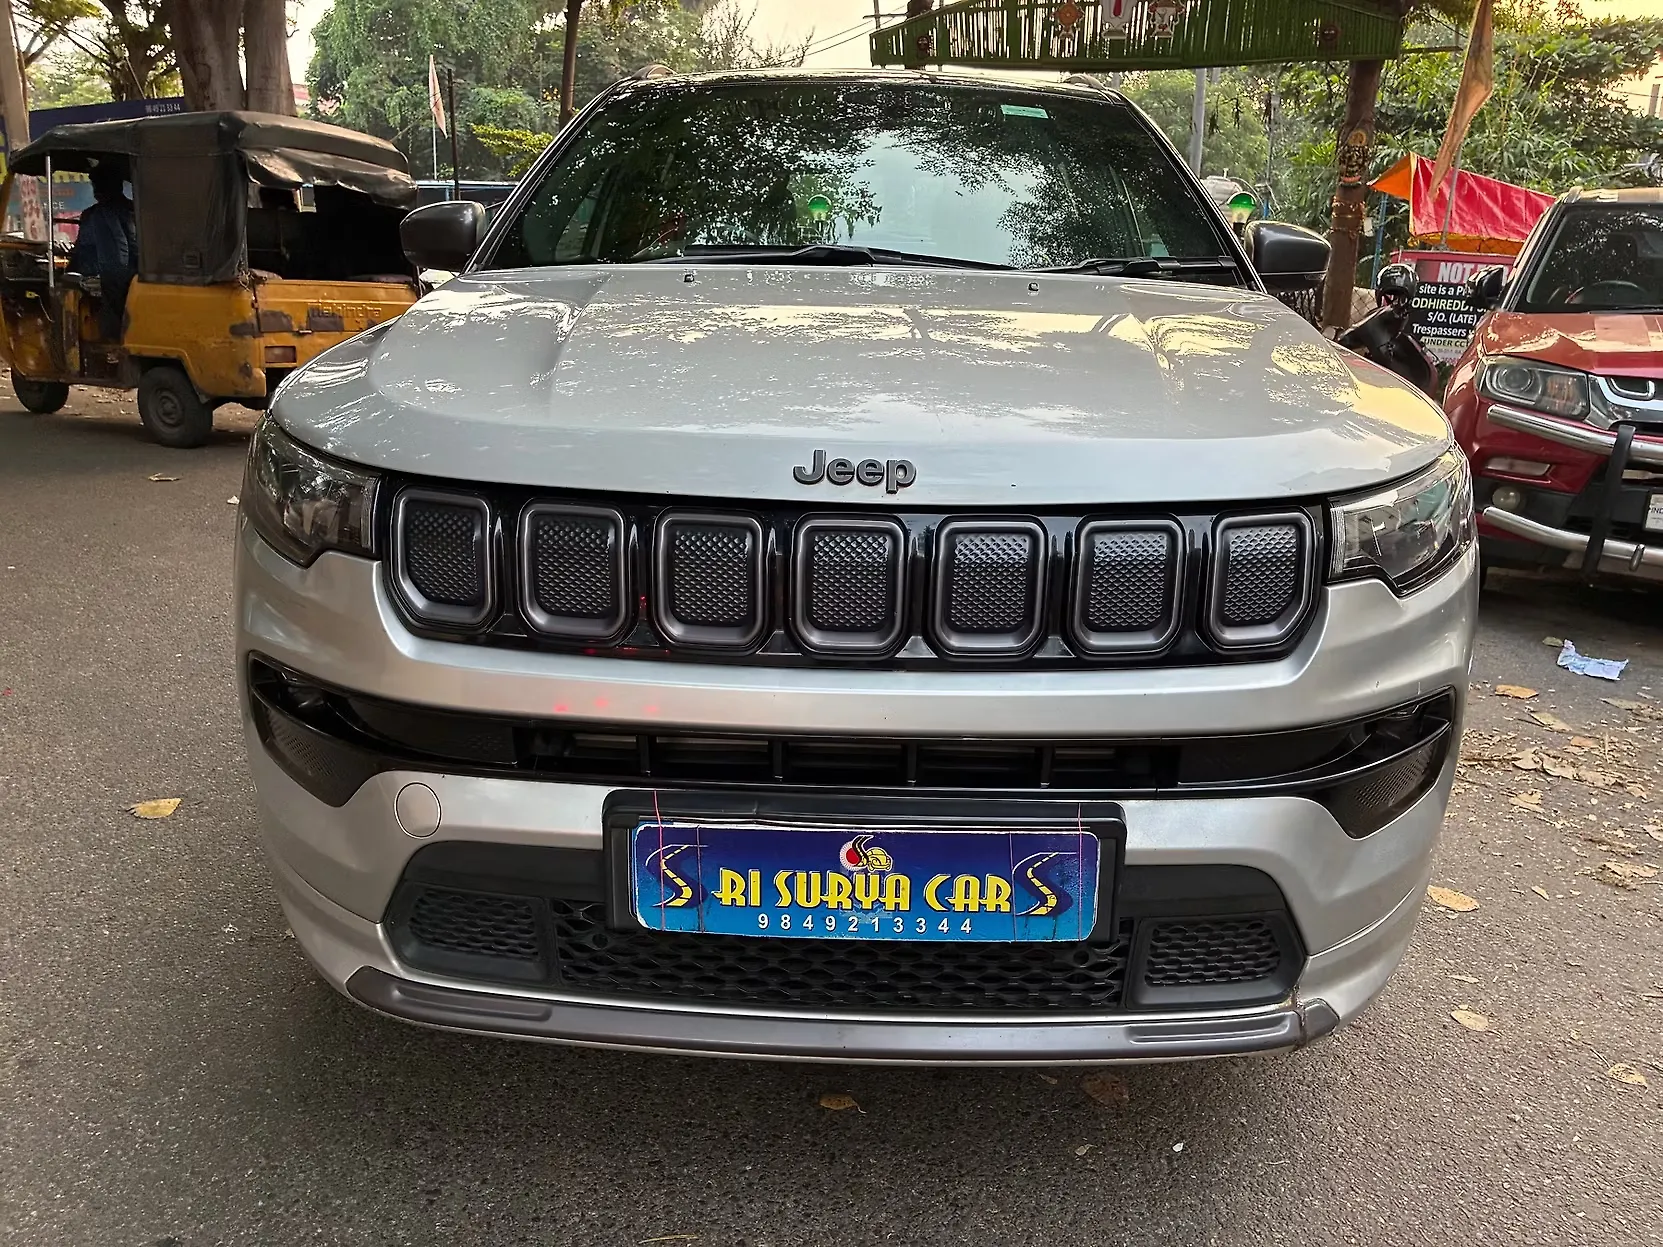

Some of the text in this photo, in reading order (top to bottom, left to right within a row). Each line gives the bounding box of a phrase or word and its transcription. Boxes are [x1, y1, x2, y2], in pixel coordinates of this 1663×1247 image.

[1437, 261, 1475, 284] NOT
[1419, 283, 1437, 294] site
[1438, 284, 1446, 295] is
[1447, 287, 1455, 295] a
[1427, 311, 1477, 326] S/O. (LATE)
[1412, 323, 1467, 337] Trespassers
[1424, 337, 1453, 347] UNDER
[793, 449, 917, 494] Jeep
[773, 868, 911, 911] SURYA
[758, 916, 972, 935] 9849213344
